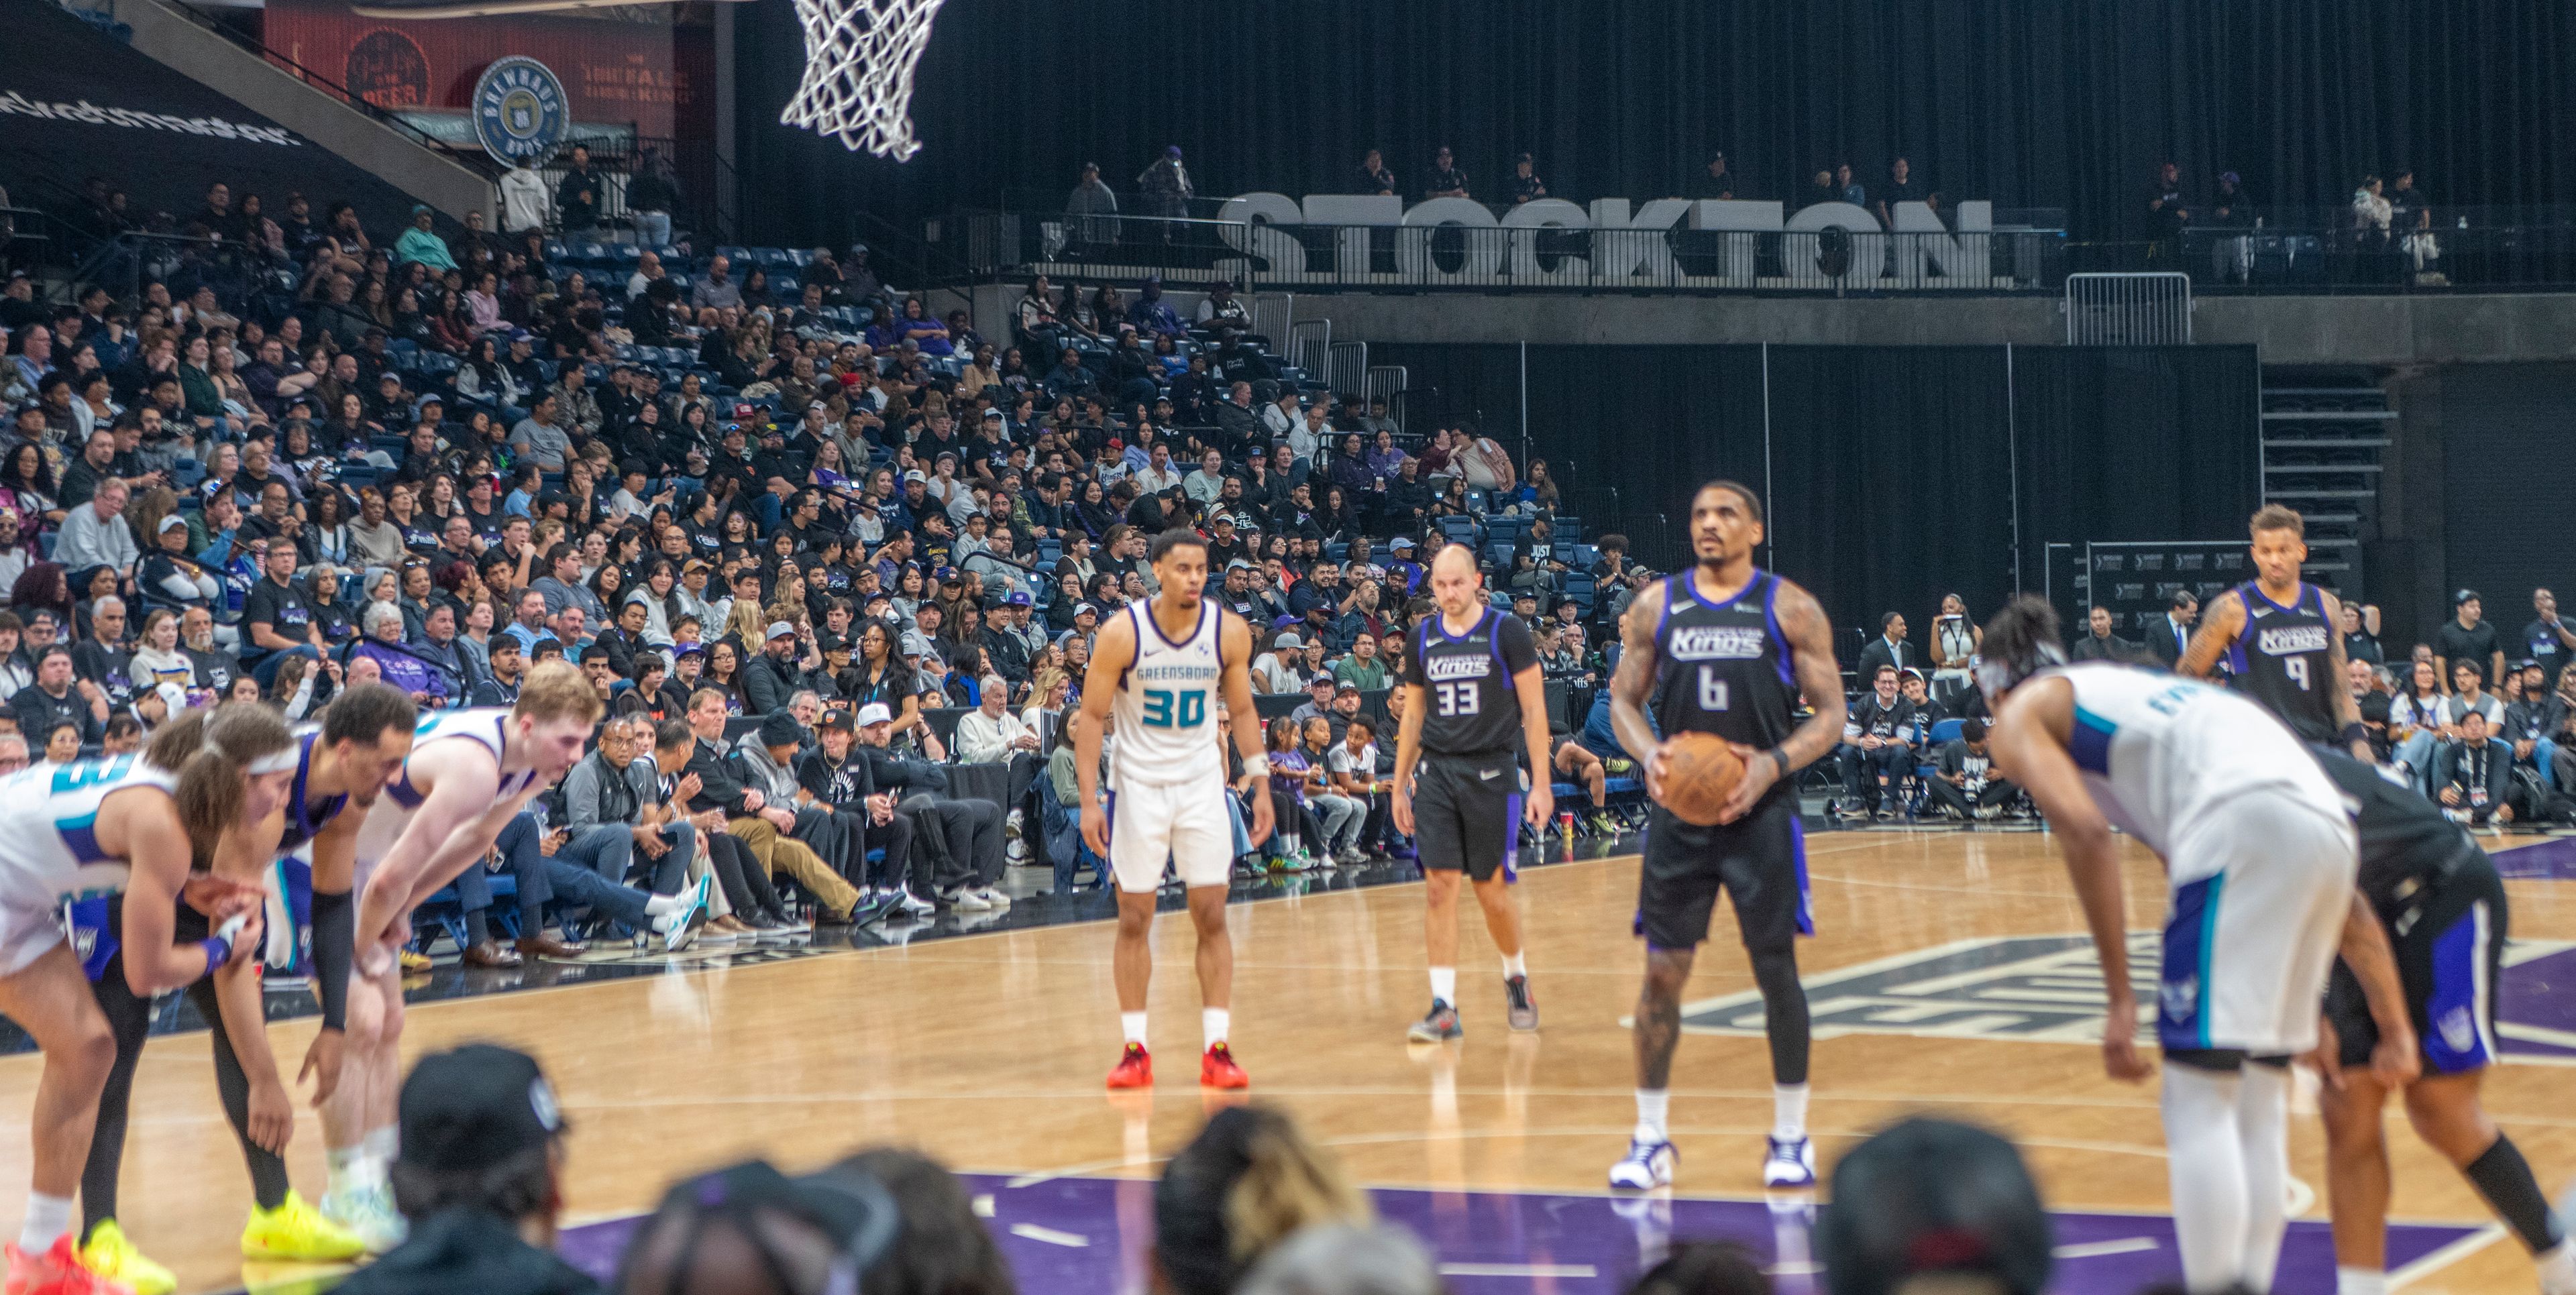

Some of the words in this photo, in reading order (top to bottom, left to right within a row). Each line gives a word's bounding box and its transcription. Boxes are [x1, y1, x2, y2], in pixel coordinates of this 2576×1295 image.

[1213, 191, 1994, 288] STOCKTON
[1531, 545, 1550, 557] JUST
[1669, 627, 1764, 662] Kings
[1137, 667, 1218, 681] GREENSBORO
[1427, 657, 1491, 682] Kings
[2284, 657, 2310, 691] 9
[1436, 682, 1479, 716] 33
[1699, 665, 1729, 711] 6
[1142, 689, 1206, 728] 30
[1963, 756, 1989, 775] NOW
